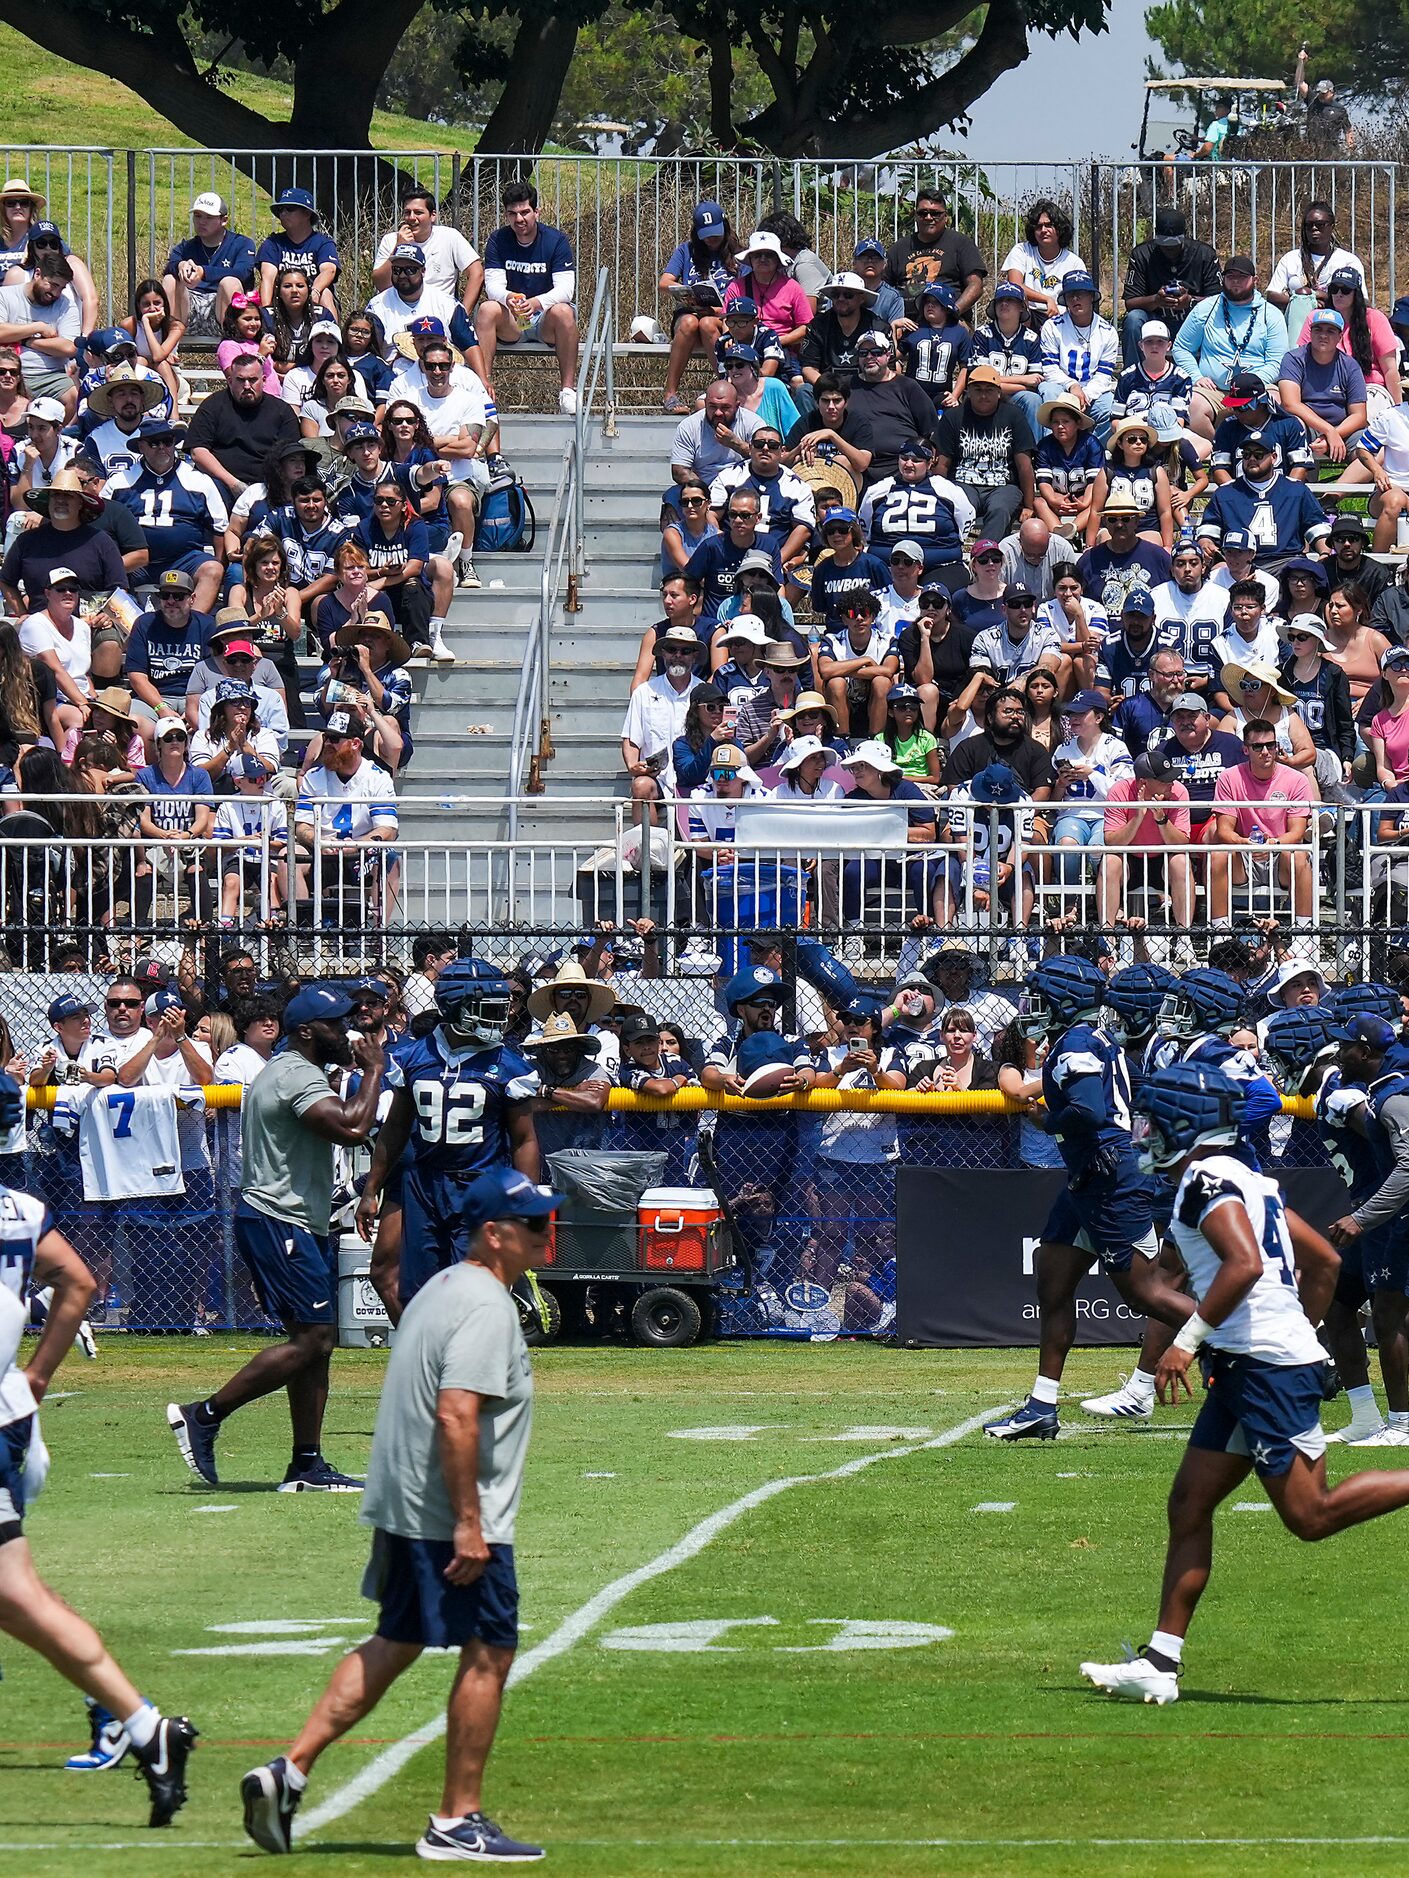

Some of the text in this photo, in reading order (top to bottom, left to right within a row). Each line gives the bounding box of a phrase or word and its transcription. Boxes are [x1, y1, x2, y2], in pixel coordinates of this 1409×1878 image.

[702, 212, 713, 225] D
[505, 260, 547, 274] COWBOYS
[915, 339, 952, 384] 11
[1068, 349, 1091, 382] 11
[140, 489, 174, 526] 11
[882, 490, 938, 533] 22
[1248, 505, 1277, 546] 4
[1016, 582, 1025, 591] NY
[147, 640, 201, 659] DALLAS
[154, 800, 191, 817] HOW
[332, 803, 353, 839] 4
[107, 1091, 136, 1138] 7
[412, 1079, 487, 1144] 92
[1262, 1195, 1294, 1287] 4
[356, 1307, 387, 1316] COWBO
[1075, 1298, 1109, 1319] RG
